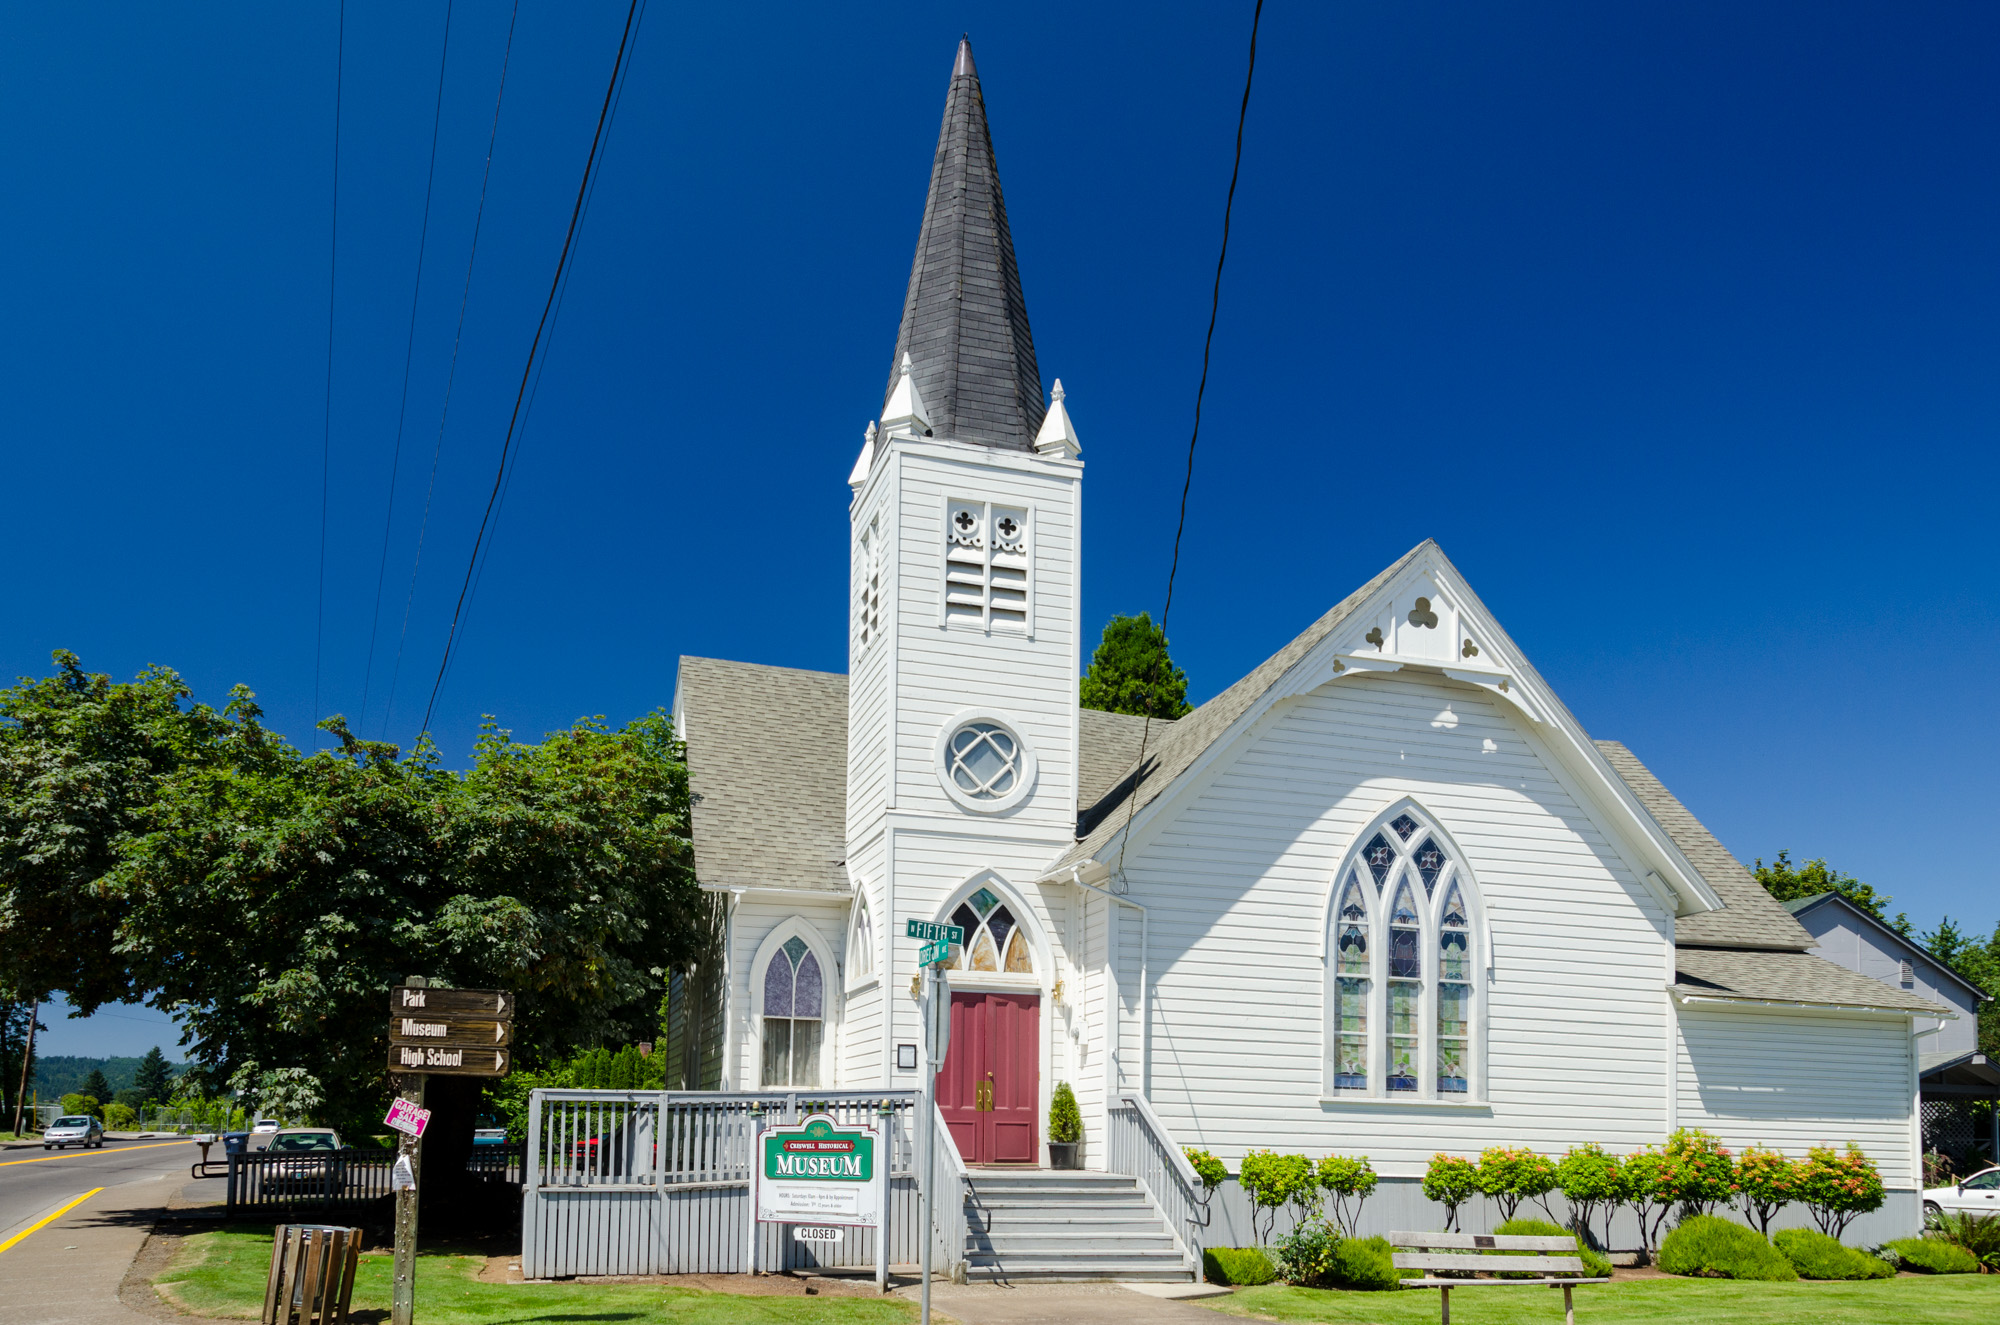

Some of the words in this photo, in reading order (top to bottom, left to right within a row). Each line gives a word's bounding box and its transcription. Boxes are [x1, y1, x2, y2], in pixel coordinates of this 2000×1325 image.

[916, 922, 948, 940] FIFTH
[951, 931, 957, 939] ST
[402, 989, 426, 1007] Park
[401, 1018, 447, 1037] Museum
[401, 1047, 425, 1067] High
[427, 1048, 463, 1067] School
[395, 1101, 428, 1121] GARAGE
[397, 1110, 420, 1126] SALE
[775, 1153, 862, 1176] MUSEUM
[801, 1228, 836, 1240] CLOSED
